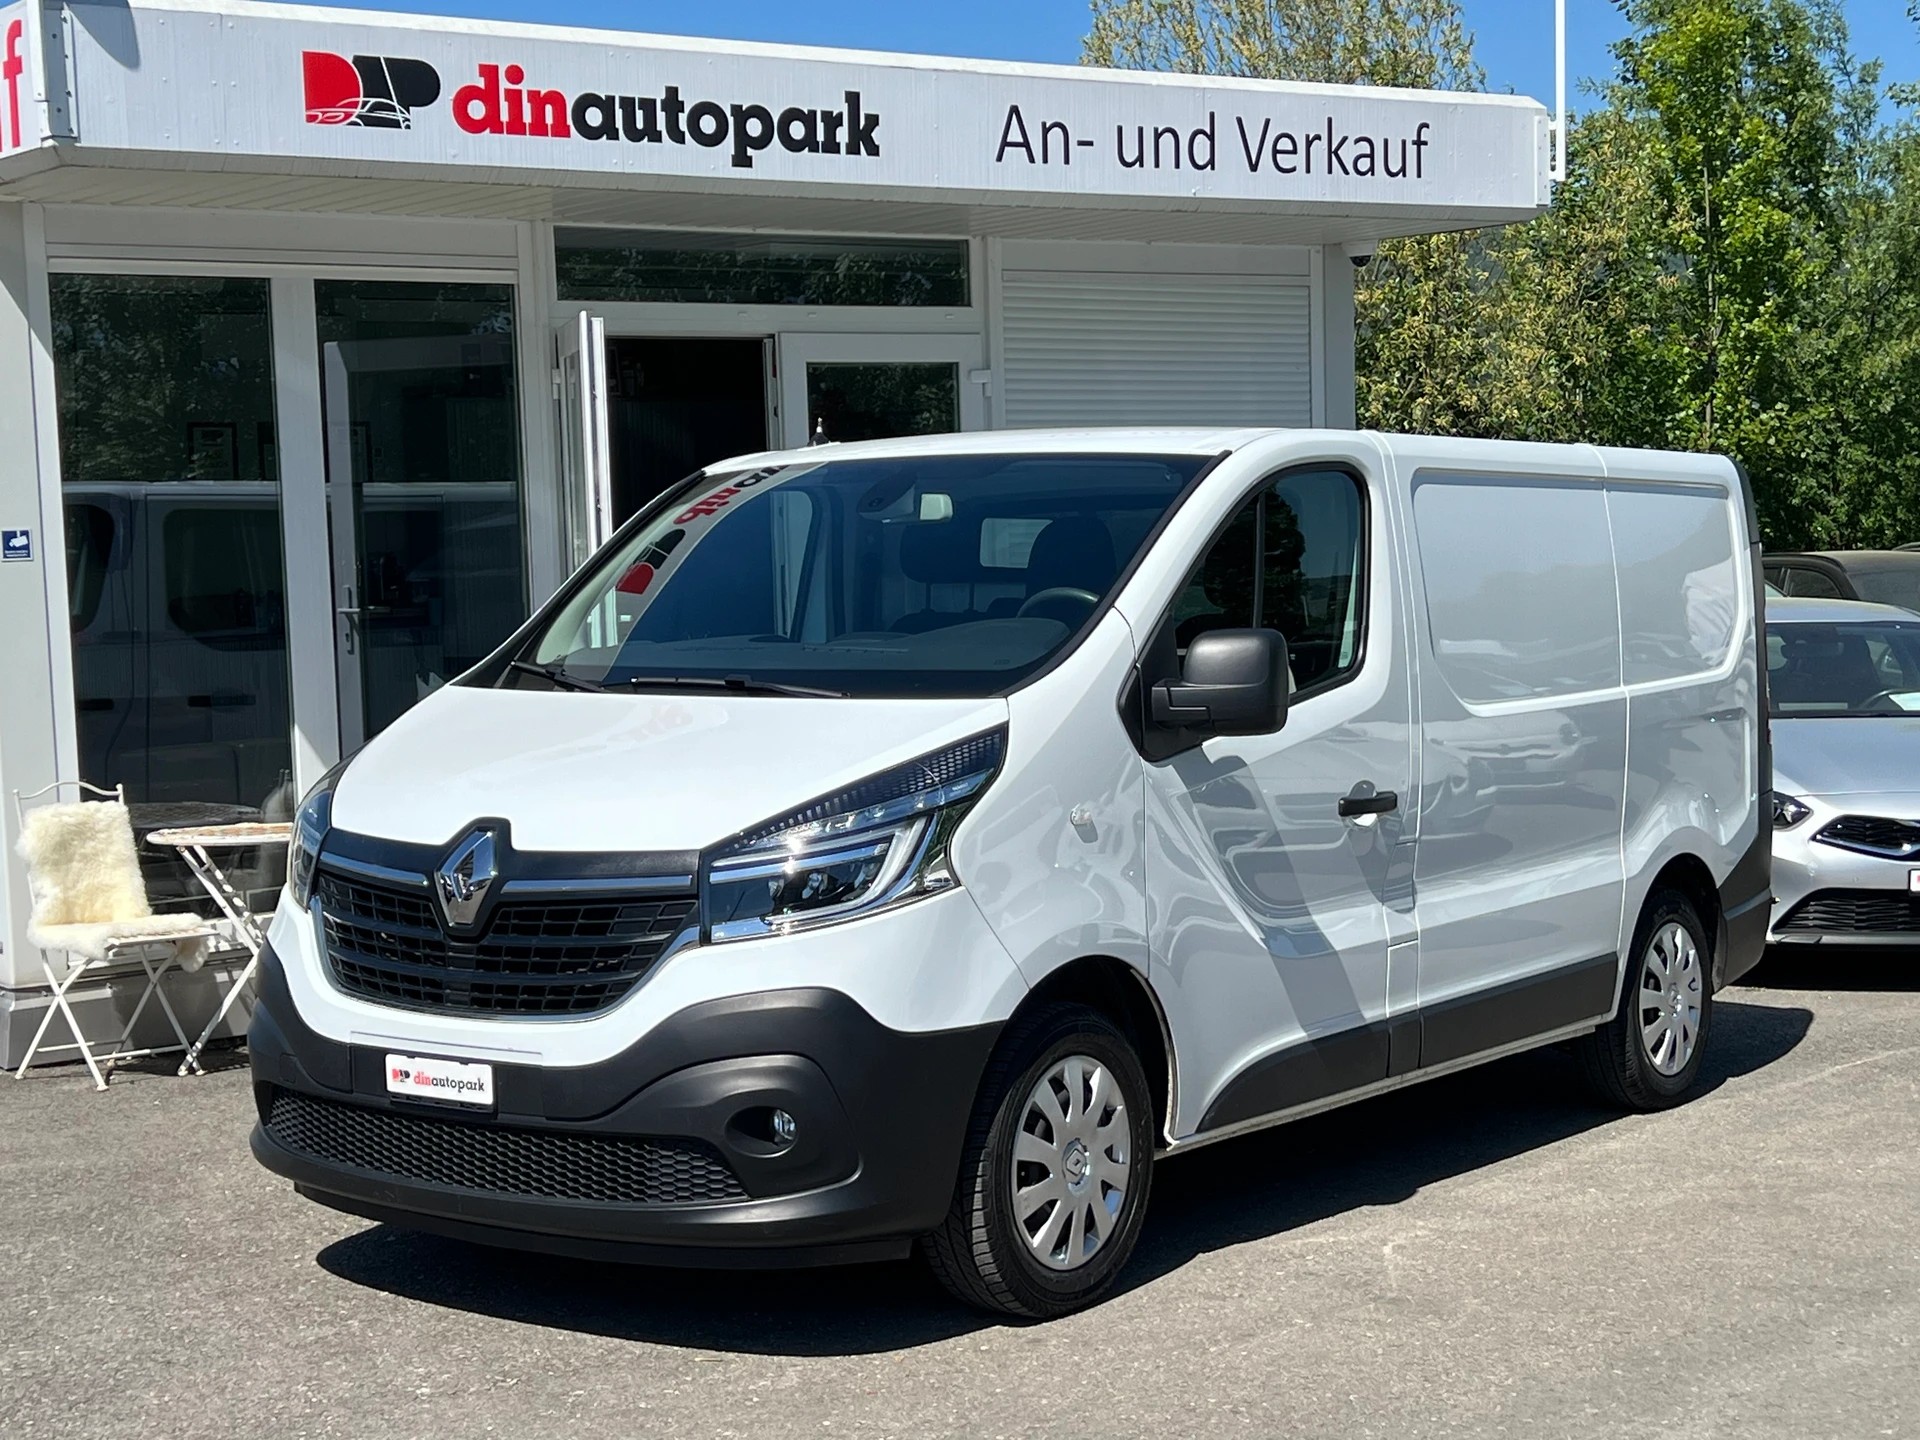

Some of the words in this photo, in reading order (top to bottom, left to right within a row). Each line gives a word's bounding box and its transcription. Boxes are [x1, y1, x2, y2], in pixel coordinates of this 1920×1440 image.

[453, 64, 880, 168] dinautopark
[996, 104, 1094, 165] An-
[1117, 111, 1215, 170] und
[1236, 116, 1430, 179] Verkauf
[414, 1071, 485, 1093] dinautopark
